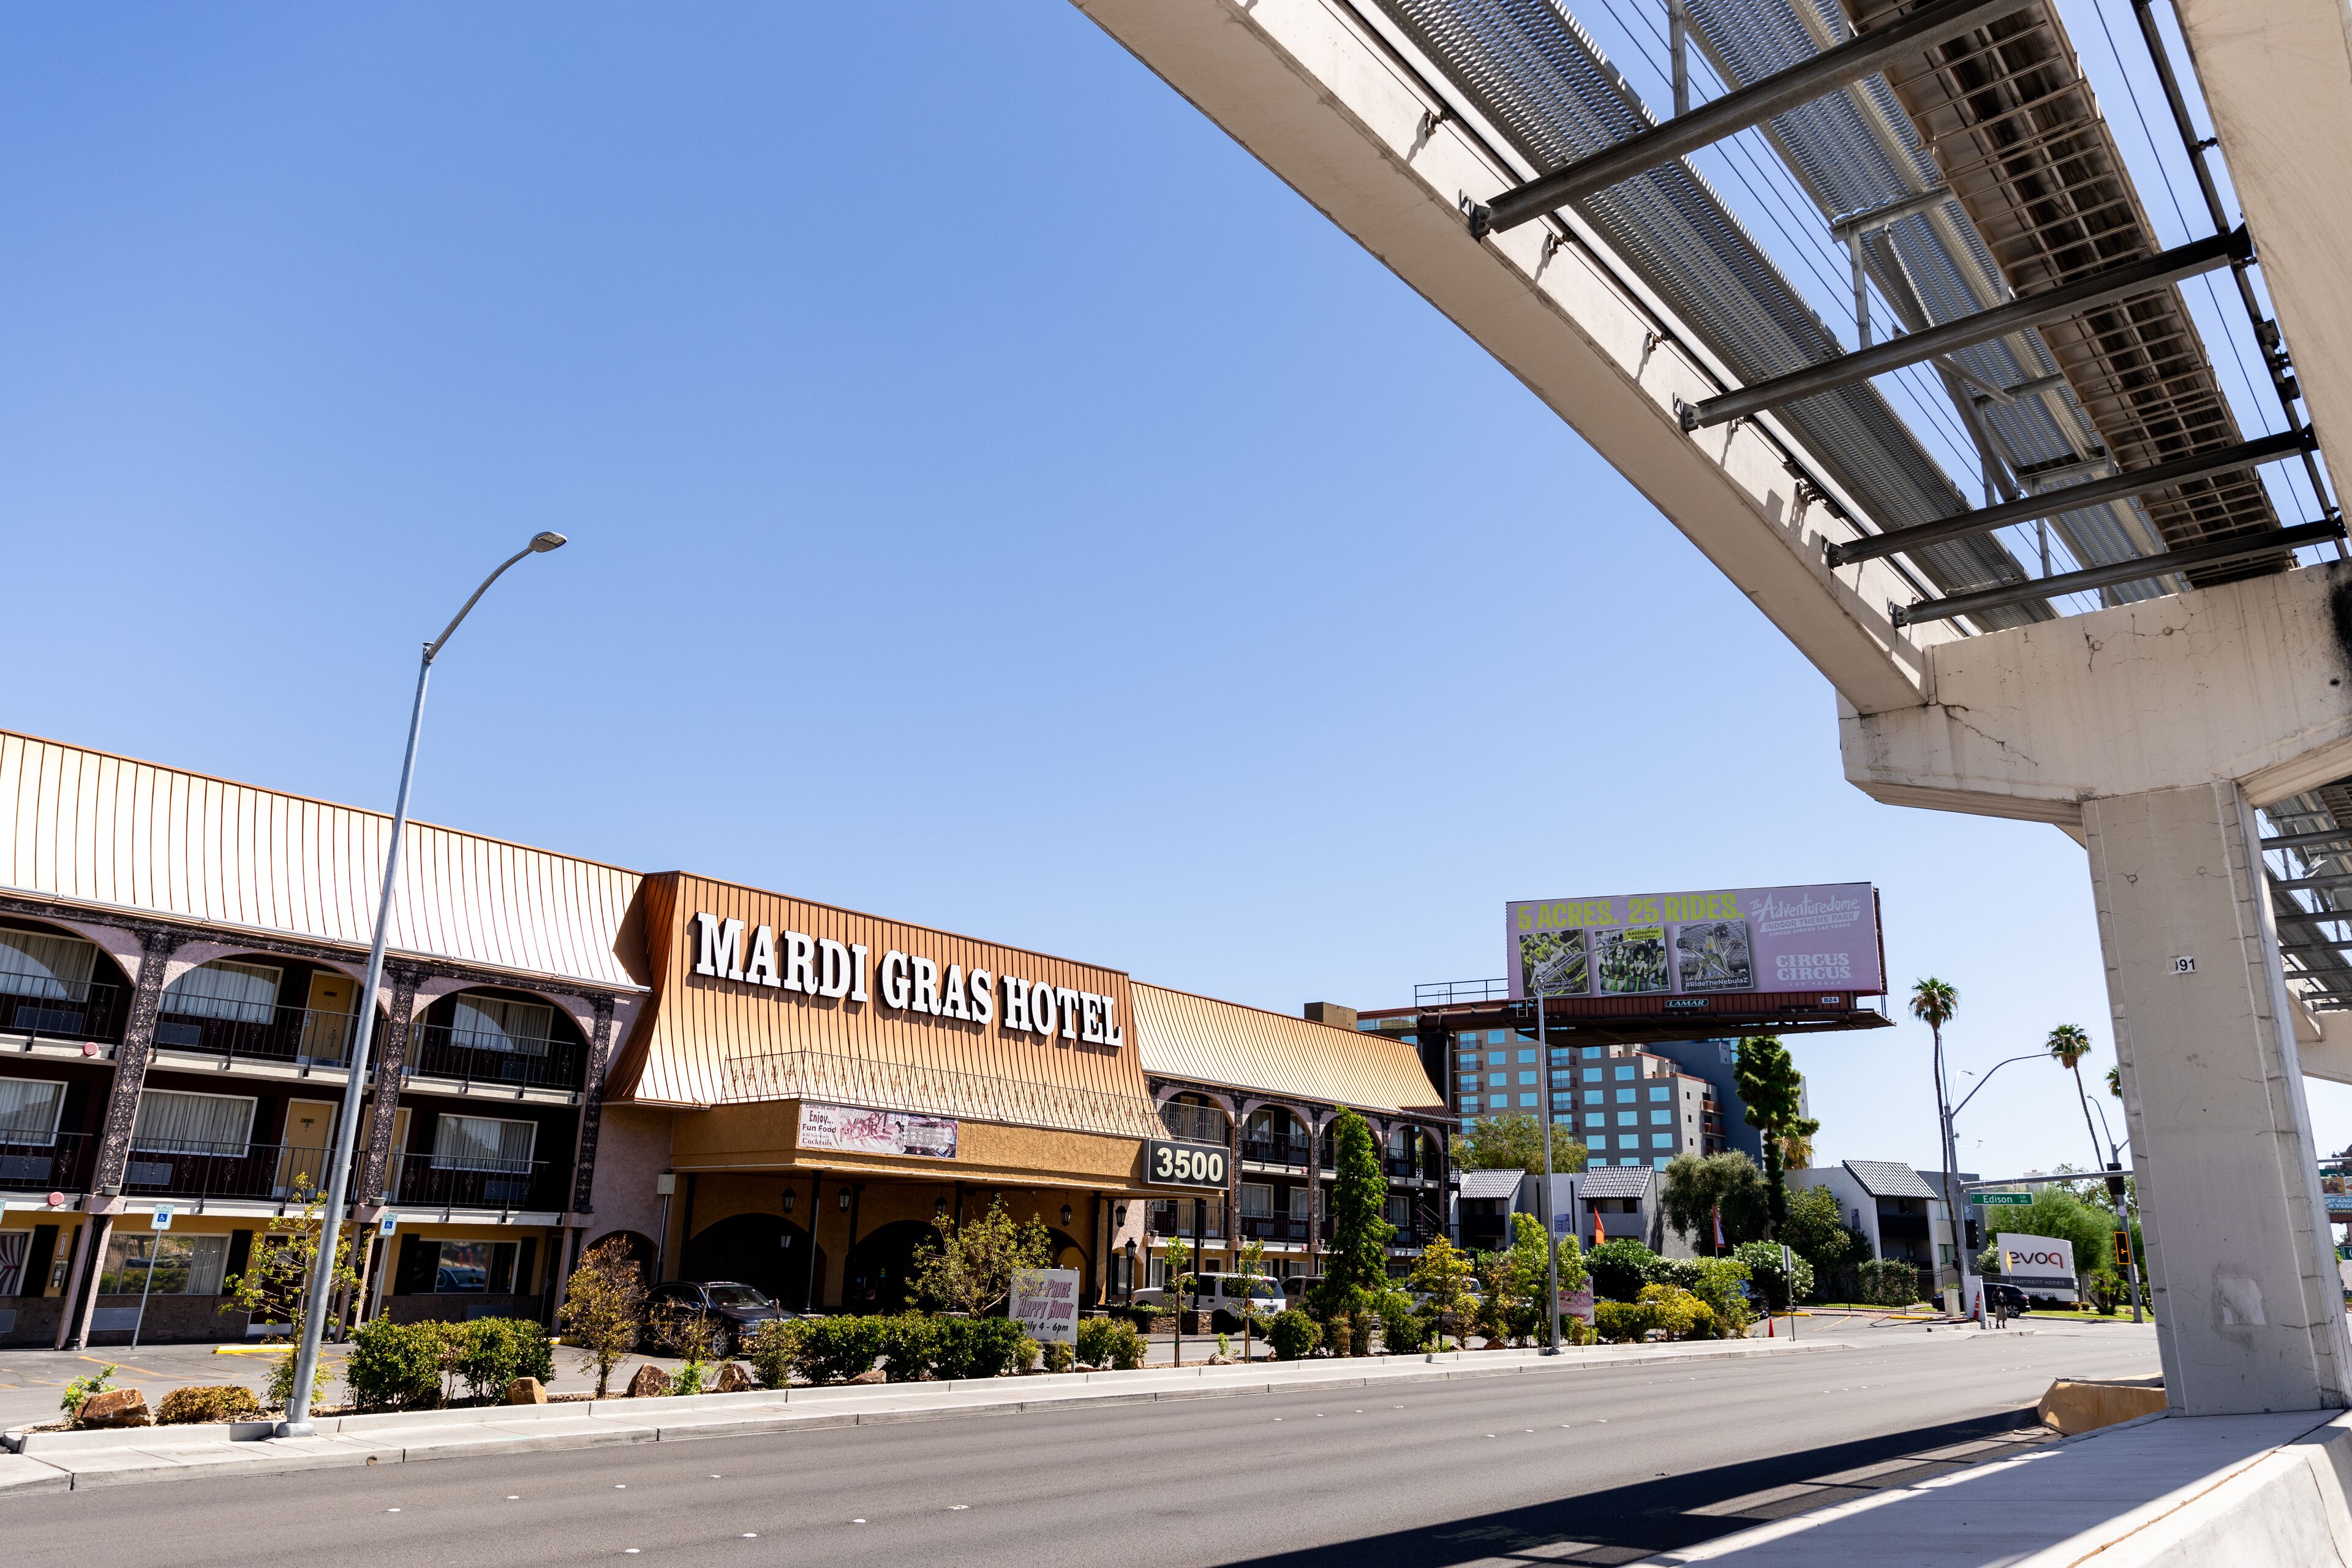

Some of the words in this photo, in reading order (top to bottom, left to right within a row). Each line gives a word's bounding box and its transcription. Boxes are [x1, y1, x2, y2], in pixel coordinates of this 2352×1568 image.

[1518, 905, 1532, 930] 5
[1537, 900, 1619, 929] ACRES.
[1628, 897, 1659, 924] 25
[1664, 893, 1744, 922] RIDES.
[1749, 896, 1763, 910] The
[1751, 892, 1860, 924] Adventuredome
[1765, 920, 1797, 931] INDOOR
[1798, 916, 1830, 926] THEME
[1831, 913, 1855, 922] PARK
[1775, 952, 1850, 968] CIRCUS
[694, 910, 869, 1003] MARDI
[880, 949, 994, 1025] GRAS
[1001, 973, 1123, 1047] HOTEL
[1685, 977, 1749, 987] #RideTheNebulaZ
[1776, 966, 1852, 981] CIRCUS
[809, 1110, 834, 1125] Enjoy...
[802, 1137, 832, 1146] Cocktails
[1156, 1147, 1223, 1182] 3500
[2009, 1251, 2064, 1269] evoq
[1016, 1299, 1048, 1319] HAPPY
[1047, 1300, 1072, 1321] HOUR
[1025, 1321, 1037, 1333] ily
[1038, 1322, 1044, 1331] 4
[1052, 1322, 1069, 1334] 6pm
